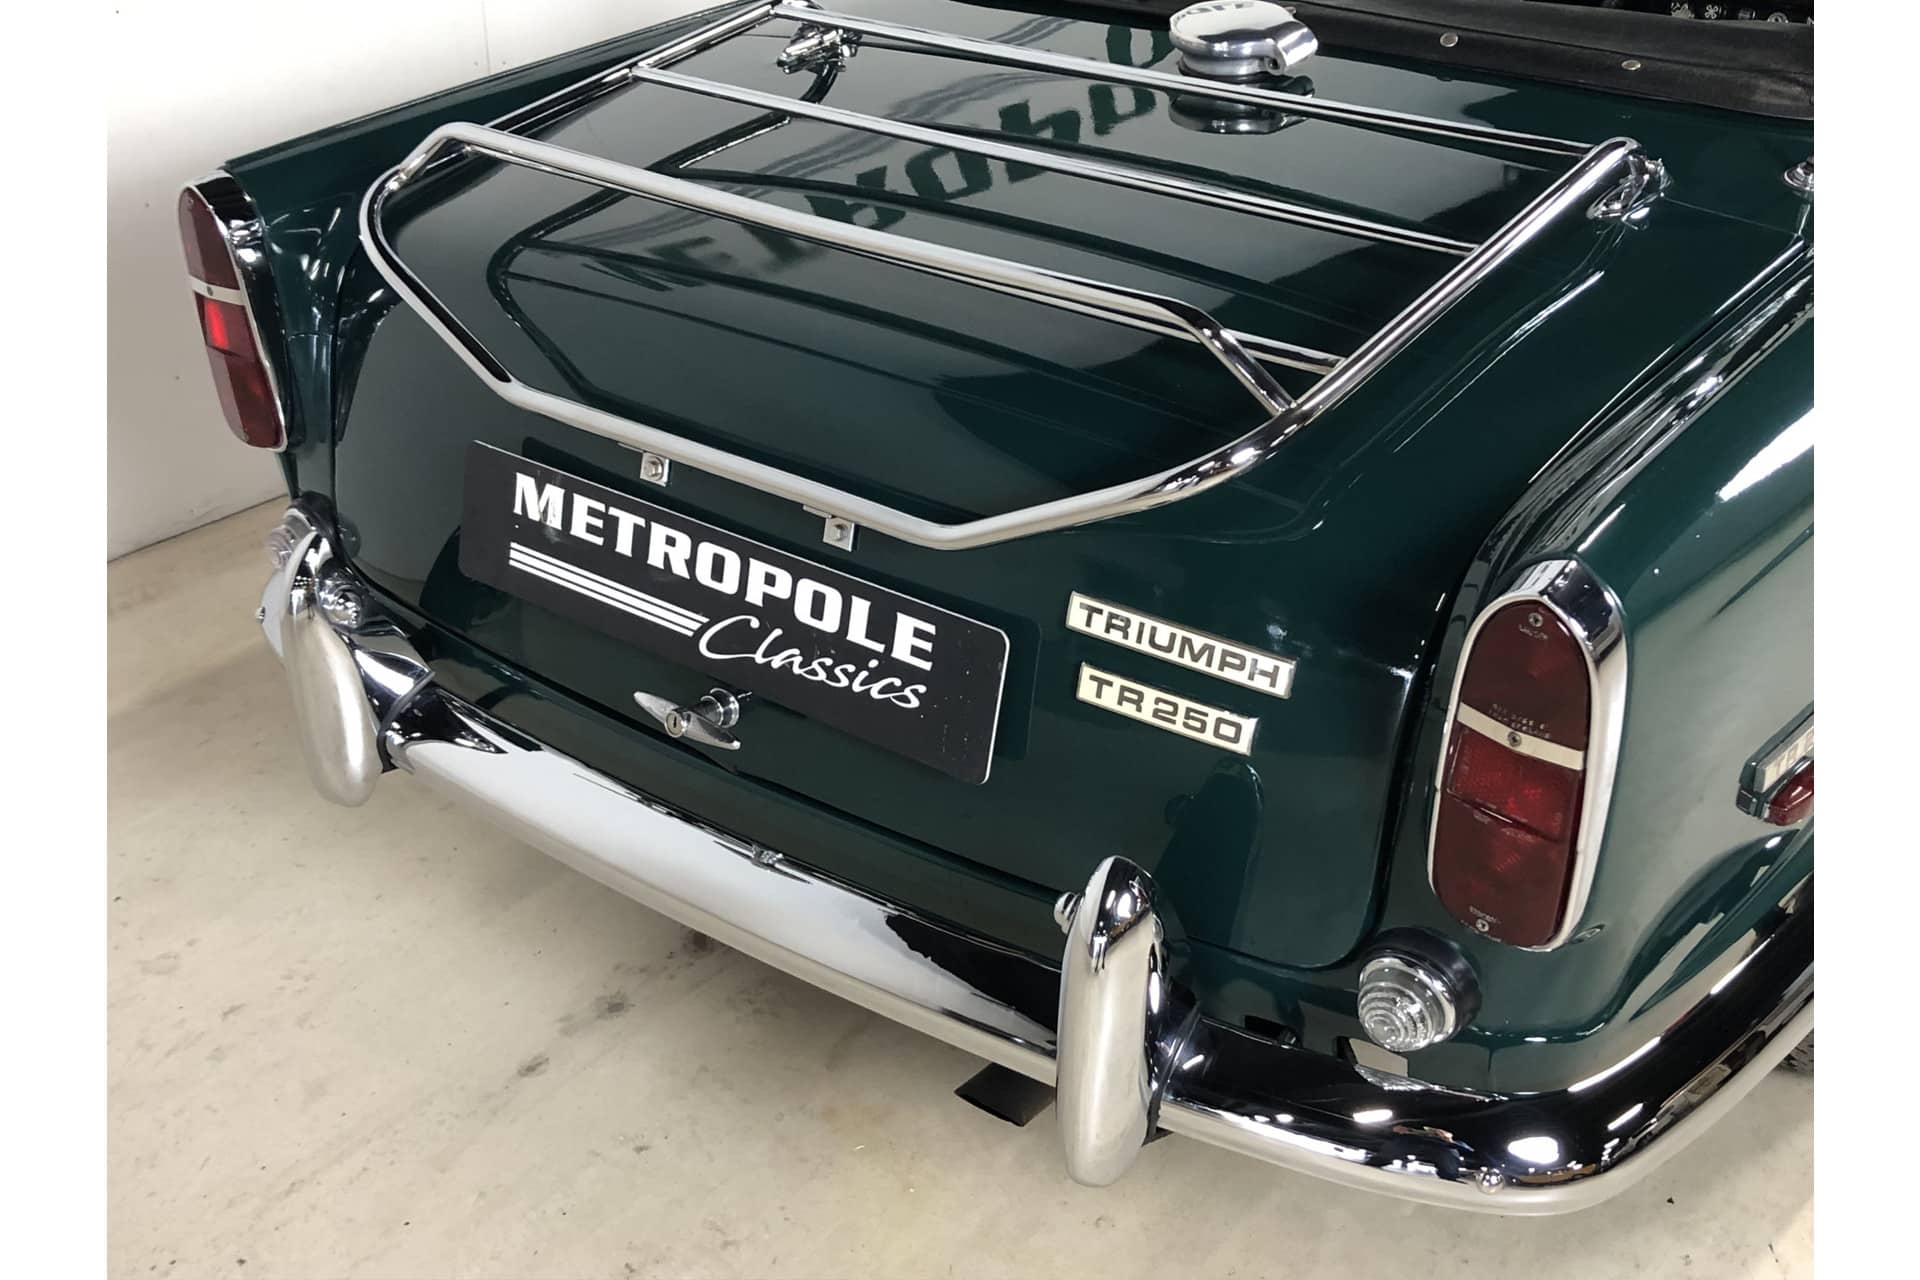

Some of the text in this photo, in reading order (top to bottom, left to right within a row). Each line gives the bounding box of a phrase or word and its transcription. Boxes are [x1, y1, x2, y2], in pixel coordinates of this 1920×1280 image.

[513, 472, 937, 671] METROPOLE
[698, 615, 927, 709] Classics
[1079, 602, 1280, 688] TRIUMPH
[1089, 674, 1243, 744] TR250
